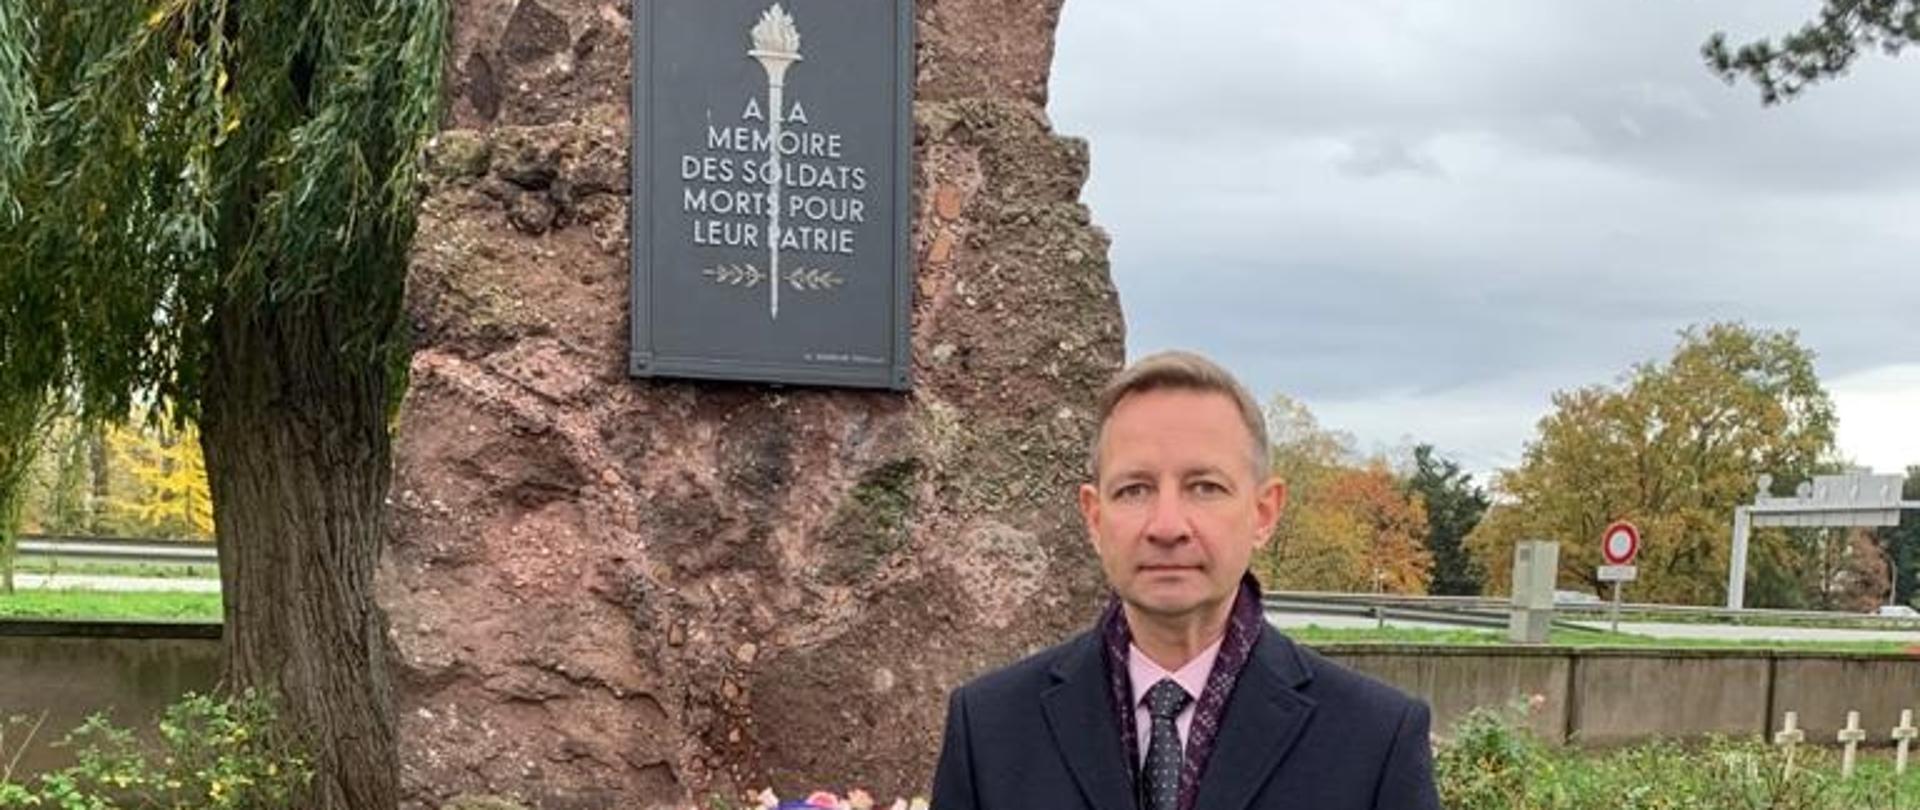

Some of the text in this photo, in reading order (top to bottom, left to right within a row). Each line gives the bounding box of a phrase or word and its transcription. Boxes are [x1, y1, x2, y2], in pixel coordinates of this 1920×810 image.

[742, 97, 764, 121] A
[708, 125, 841, 157] MEMOIRE
[682, 155, 866, 190] DES SOLDATS
[684, 188, 864, 222] MORTS POUR
[694, 220, 854, 252] LEUR PATRIE
